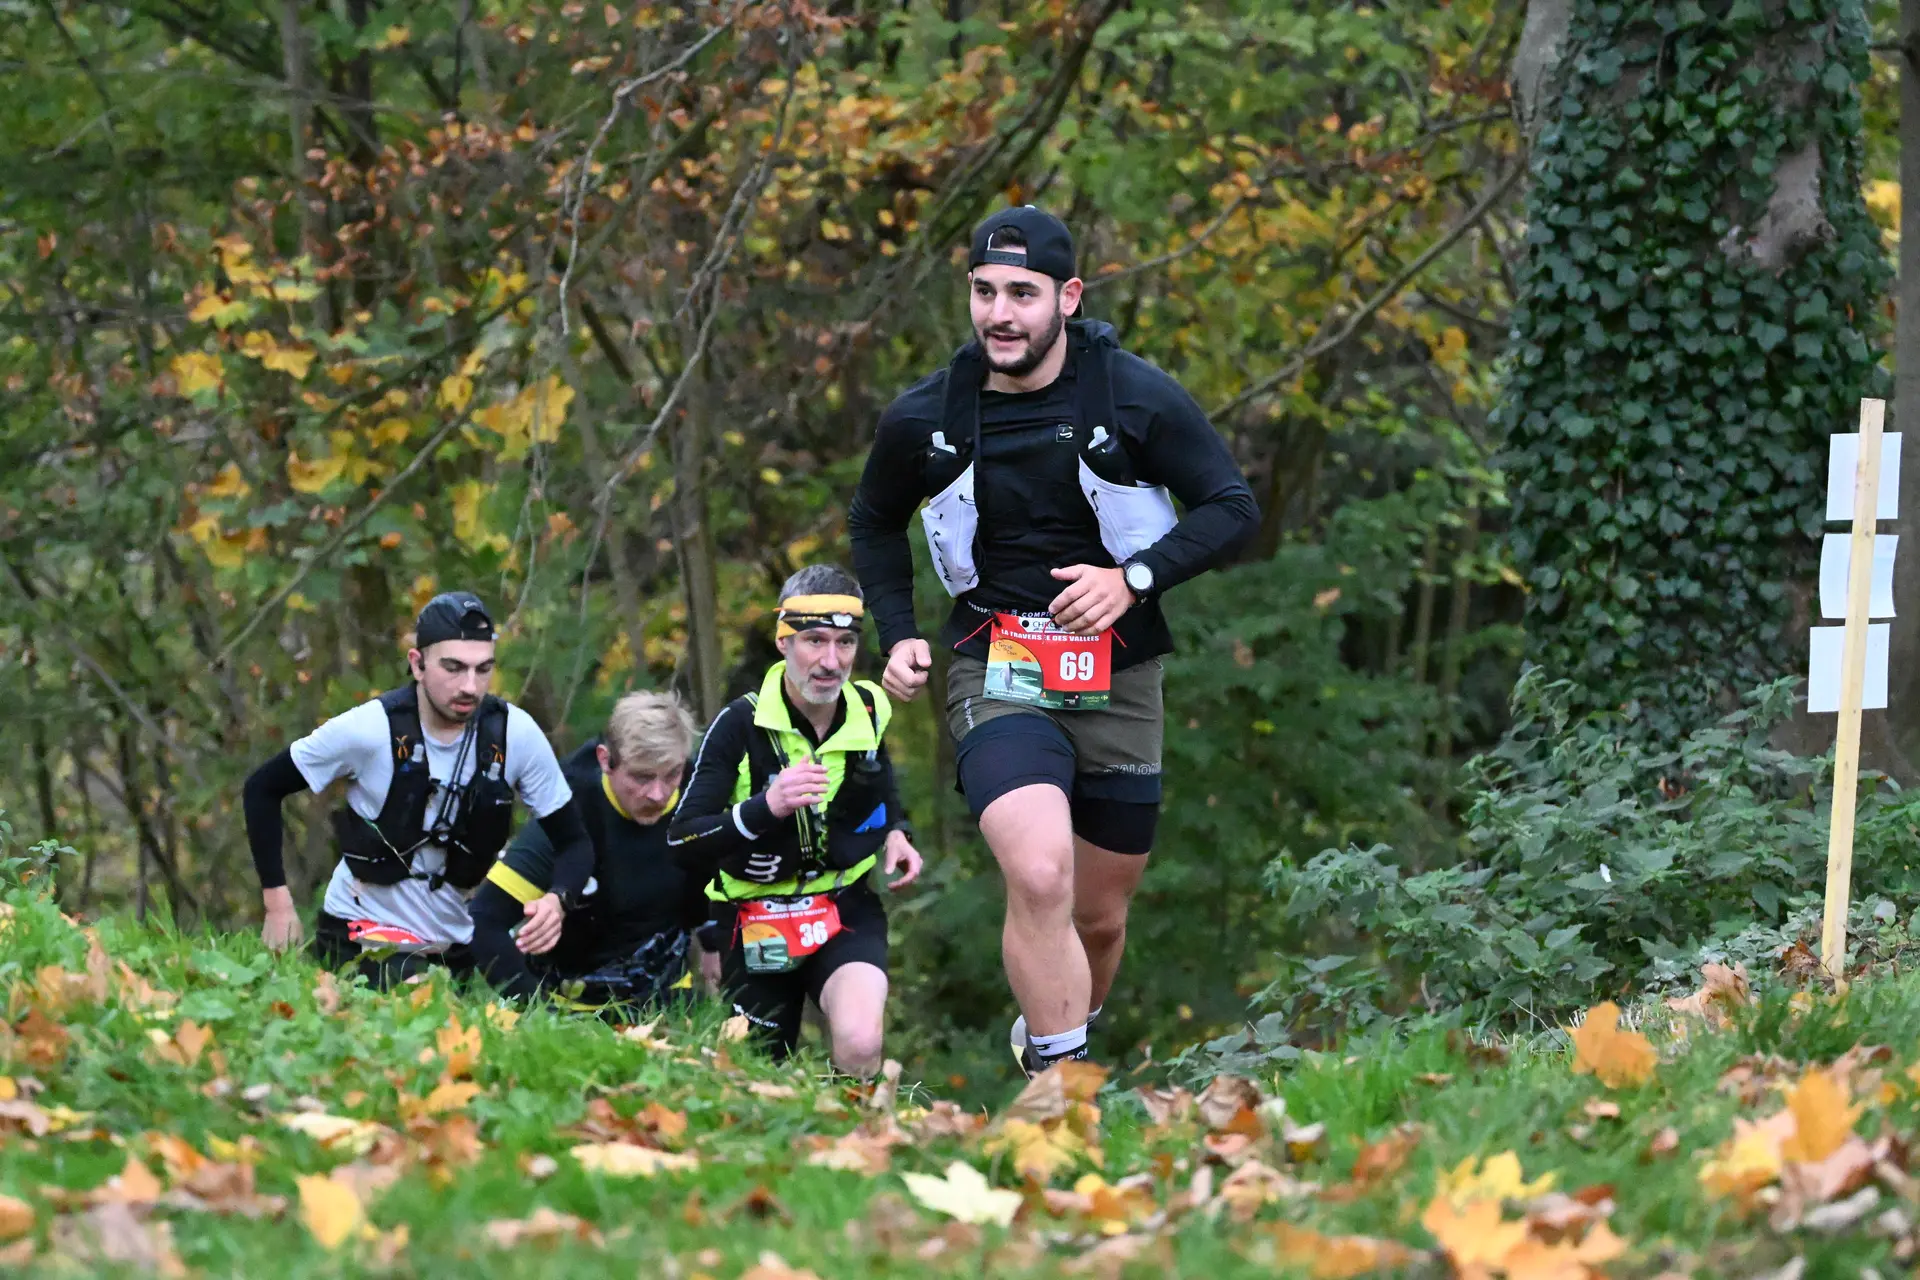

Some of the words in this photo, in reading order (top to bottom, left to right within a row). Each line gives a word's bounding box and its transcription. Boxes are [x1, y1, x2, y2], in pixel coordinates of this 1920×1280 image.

[1001, 628, 1008, 636] LA
[1059, 651, 1095, 681] 69
[799, 920, 828, 947] 36
